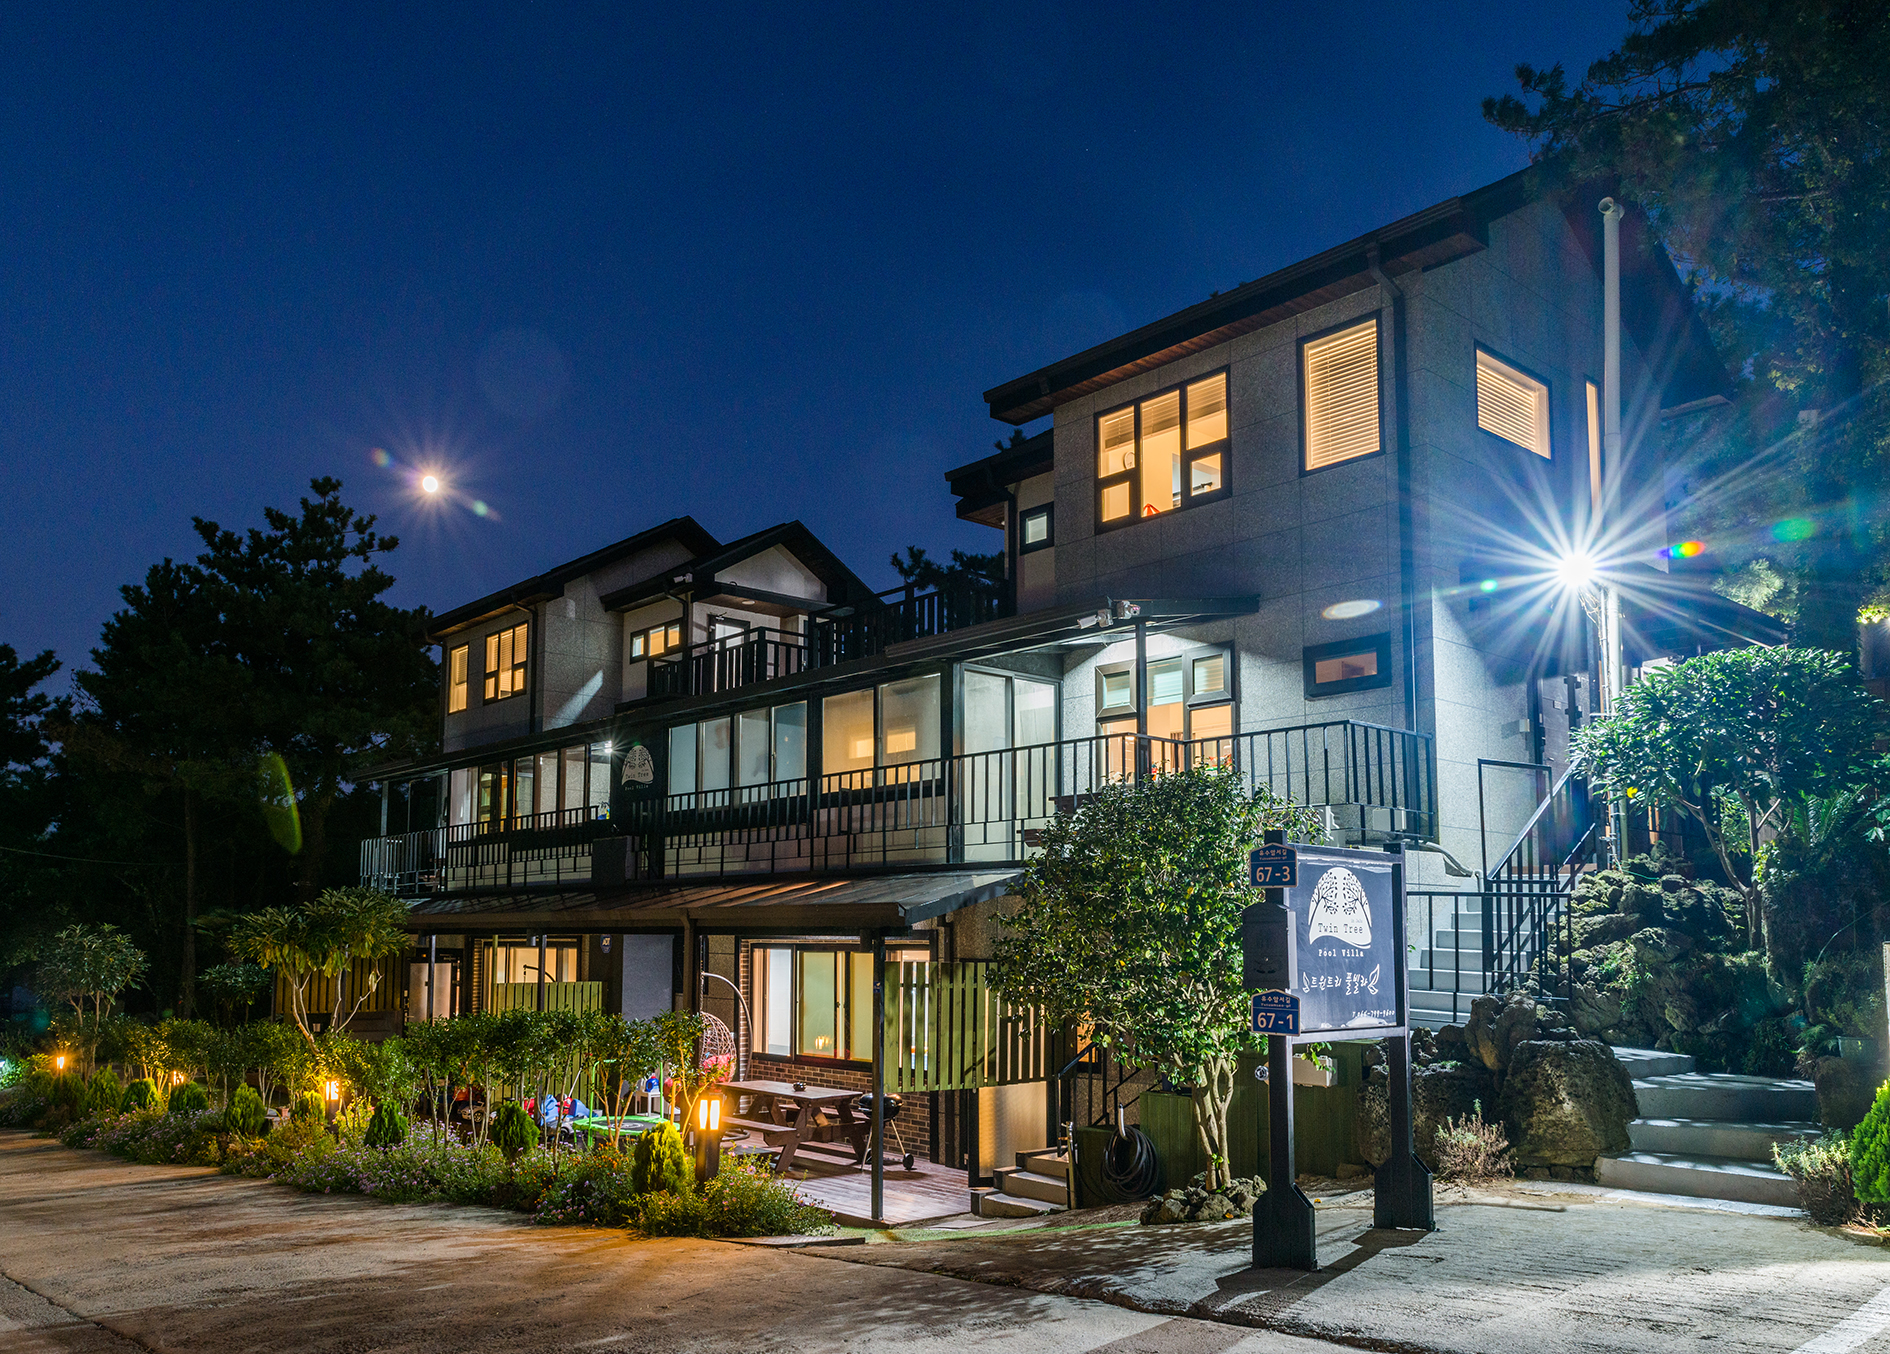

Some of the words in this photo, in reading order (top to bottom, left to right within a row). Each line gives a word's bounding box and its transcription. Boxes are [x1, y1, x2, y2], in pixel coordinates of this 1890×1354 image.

[1256, 866, 1290, 882] 67-3
[1318, 922, 1338, 933] Twin
[1343, 923, 1363, 934] Tree
[1318, 948, 1336, 957] Pool
[1341, 949, 1364, 957] Villa
[1310, 975, 1342, 991] 트윈트리
[1345, 972, 1368, 995] 풀빌라
[1257, 1012, 1293, 1030] 67-1
